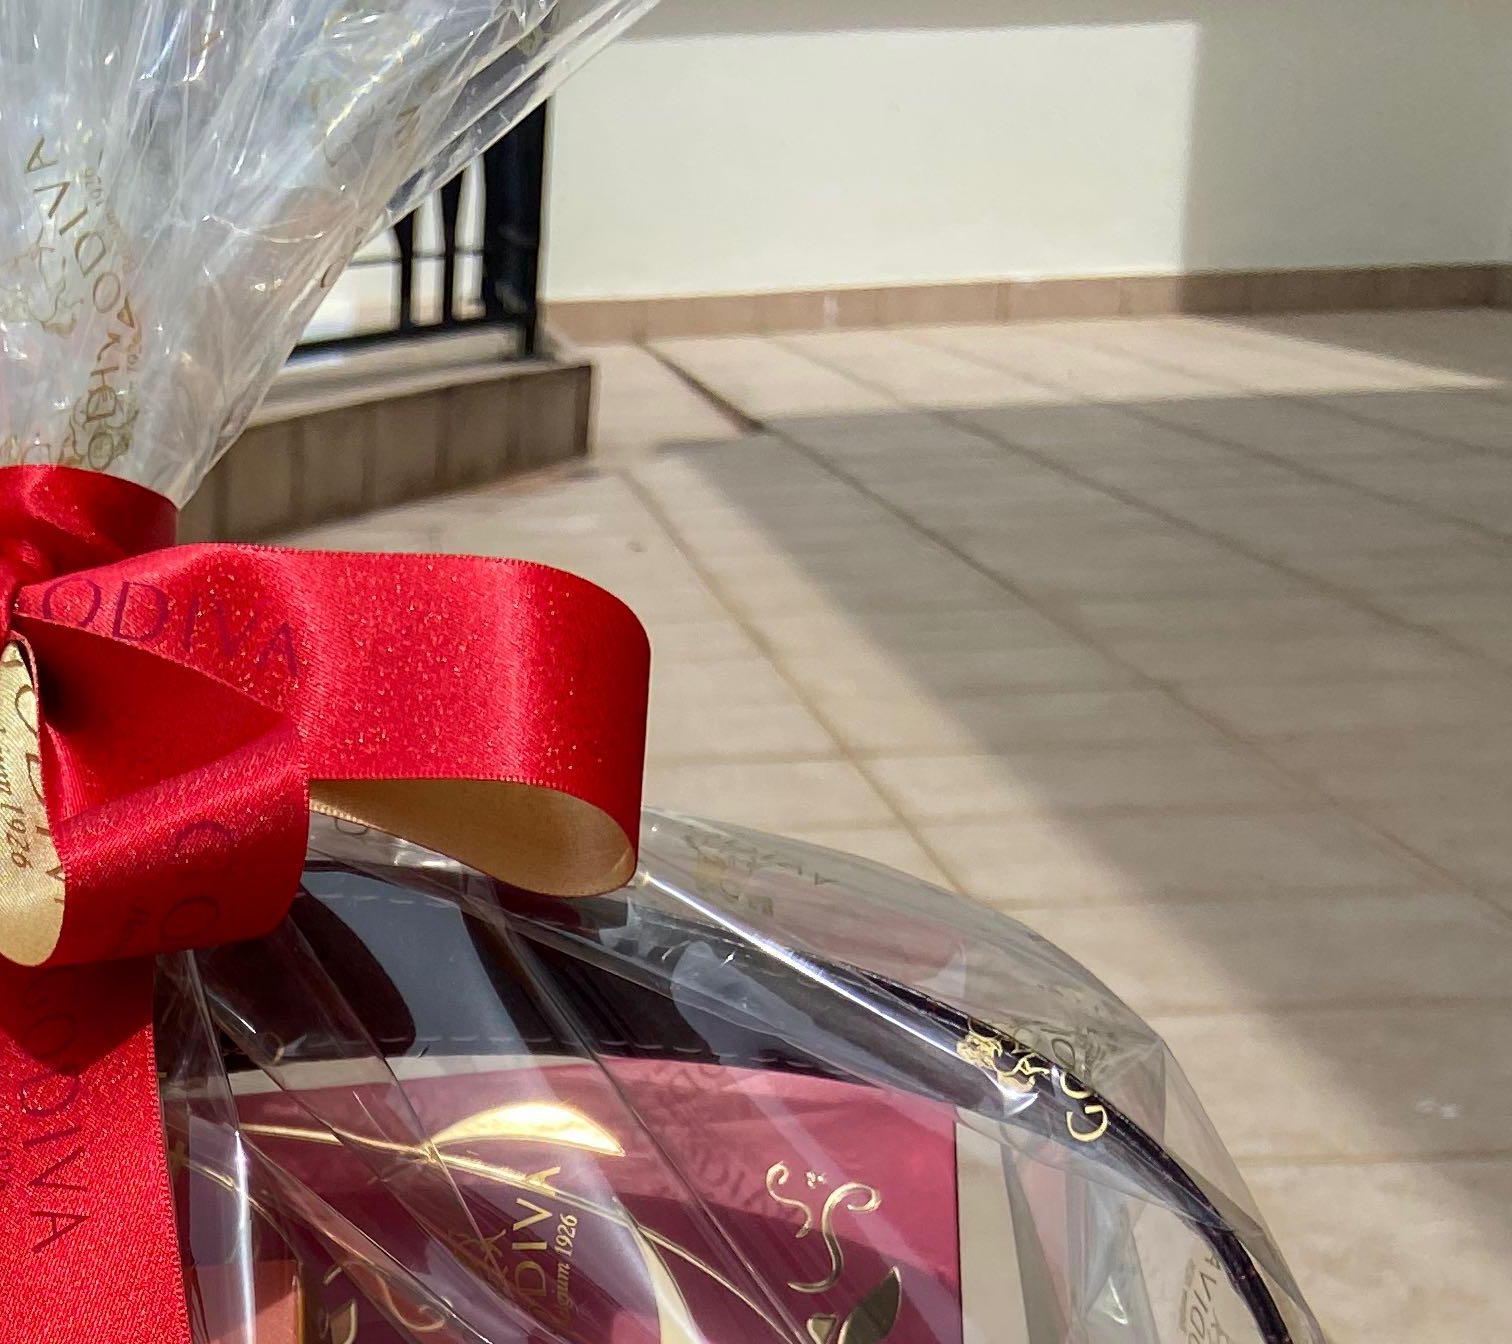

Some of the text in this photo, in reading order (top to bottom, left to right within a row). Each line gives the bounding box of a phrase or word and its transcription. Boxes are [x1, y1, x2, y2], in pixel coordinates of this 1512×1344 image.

[42, 573, 304, 682] ODIVA
[2, 801, 34, 870] 1926
[554, 1213, 579, 1257] 1926
